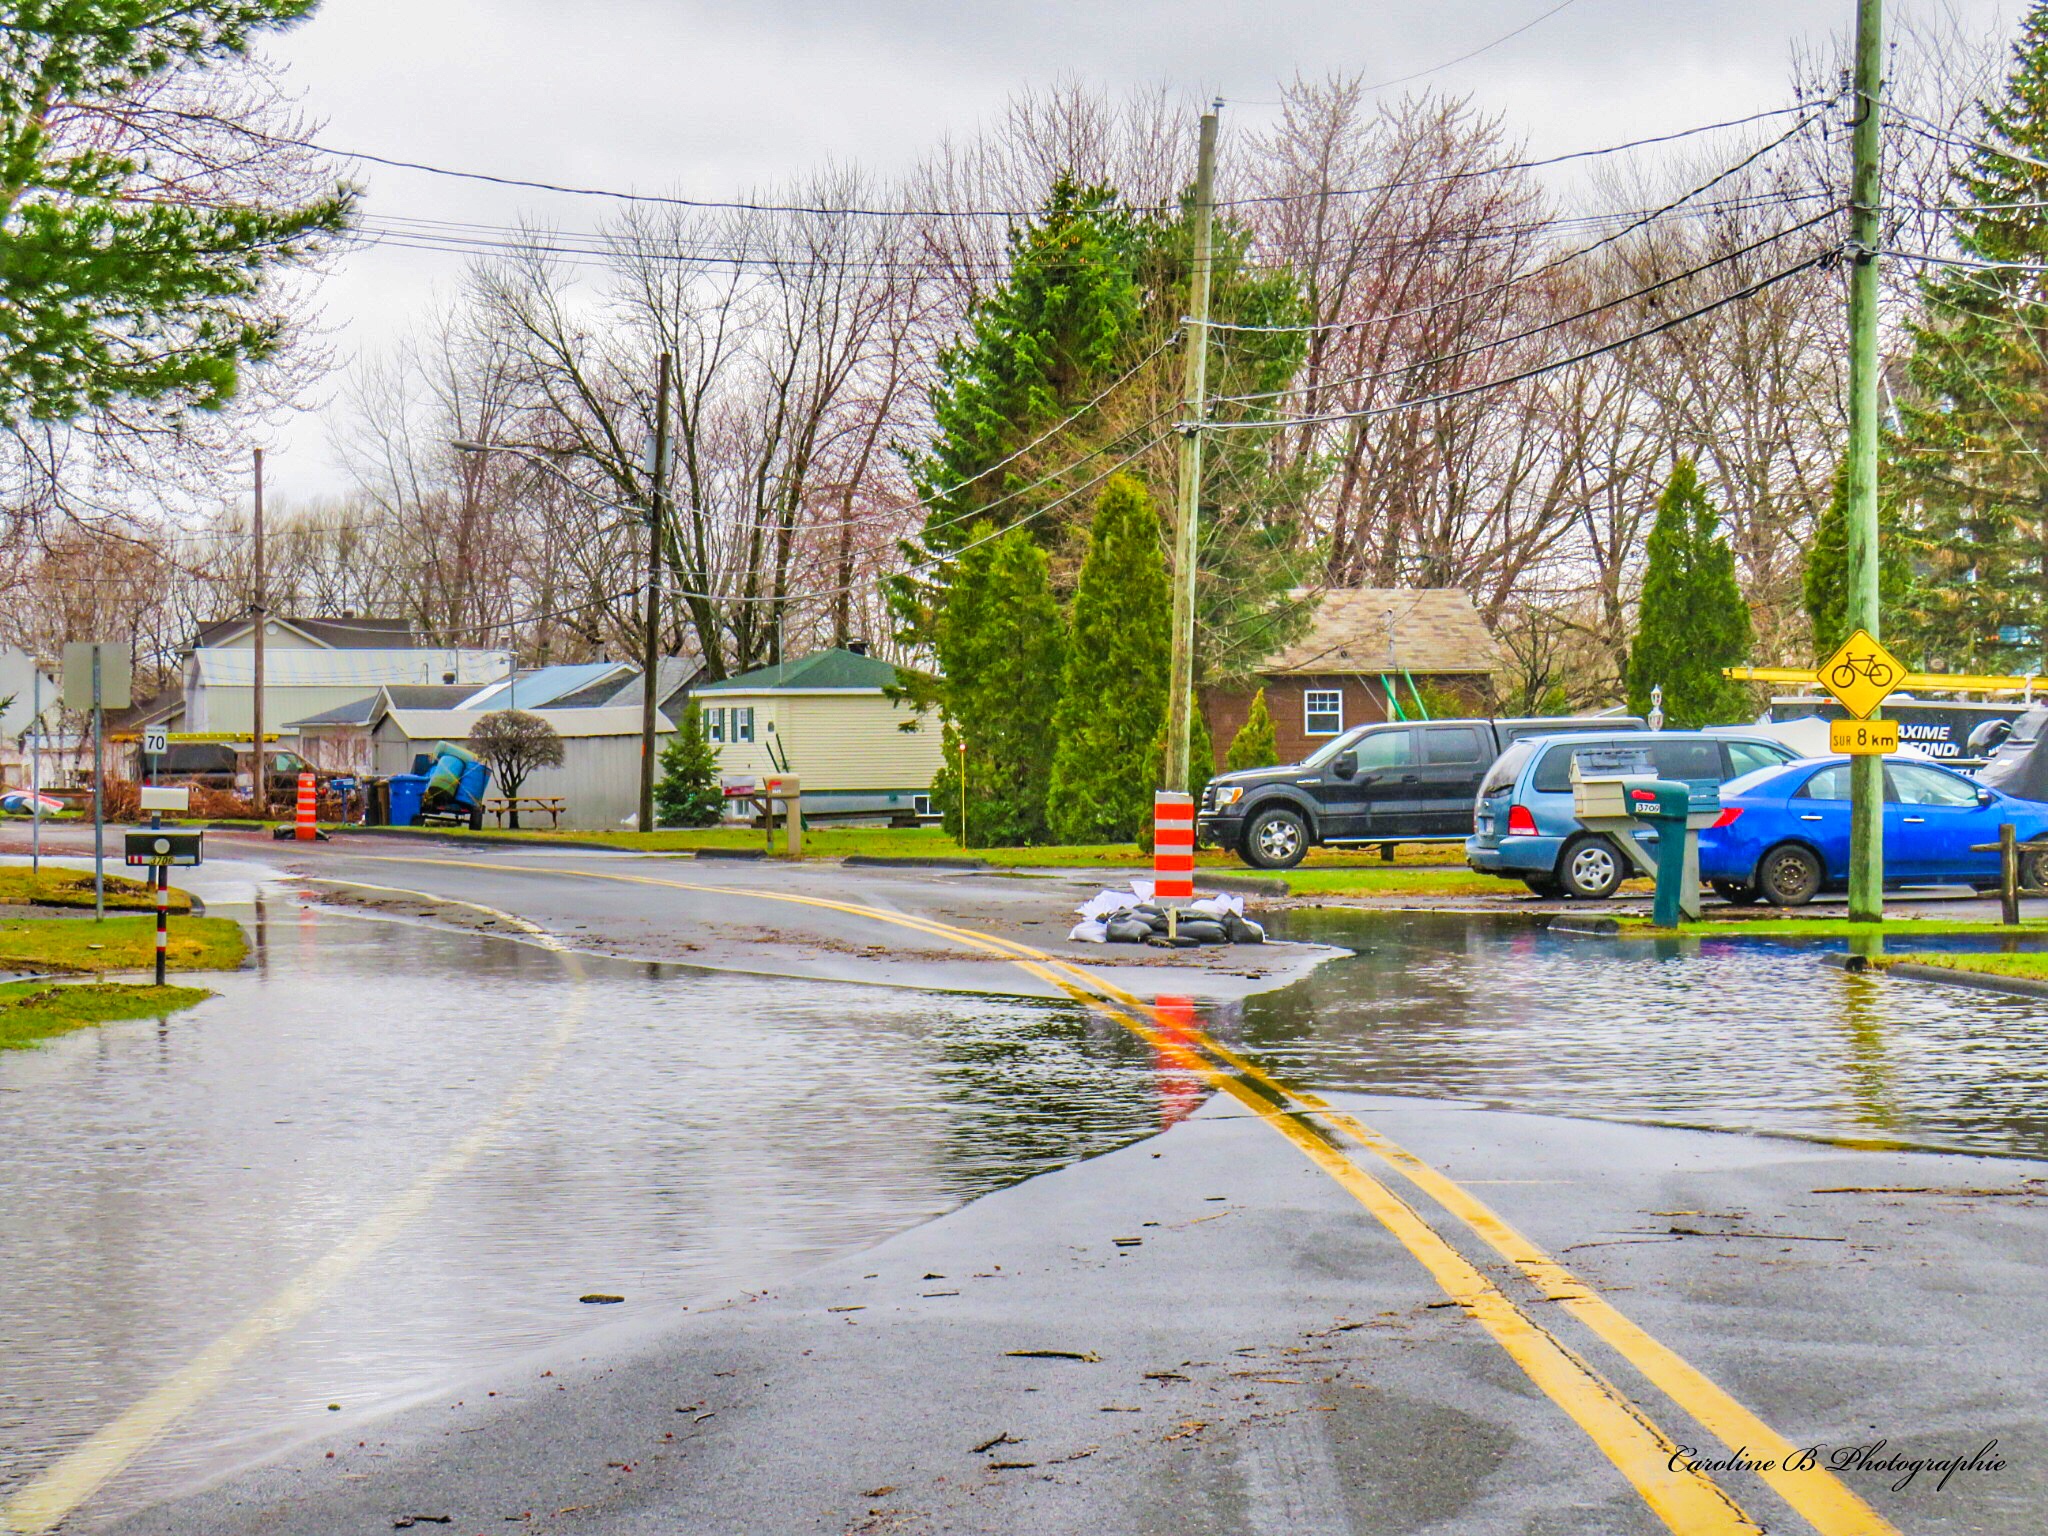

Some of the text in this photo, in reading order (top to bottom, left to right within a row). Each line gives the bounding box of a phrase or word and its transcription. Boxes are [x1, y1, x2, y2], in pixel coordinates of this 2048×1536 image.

[1833, 727, 1894, 747] SUR 8 km
[1897, 724, 1951, 741] AXIME
[147, 735, 165, 750] 70
[1637, 803, 1660, 812] 3709
